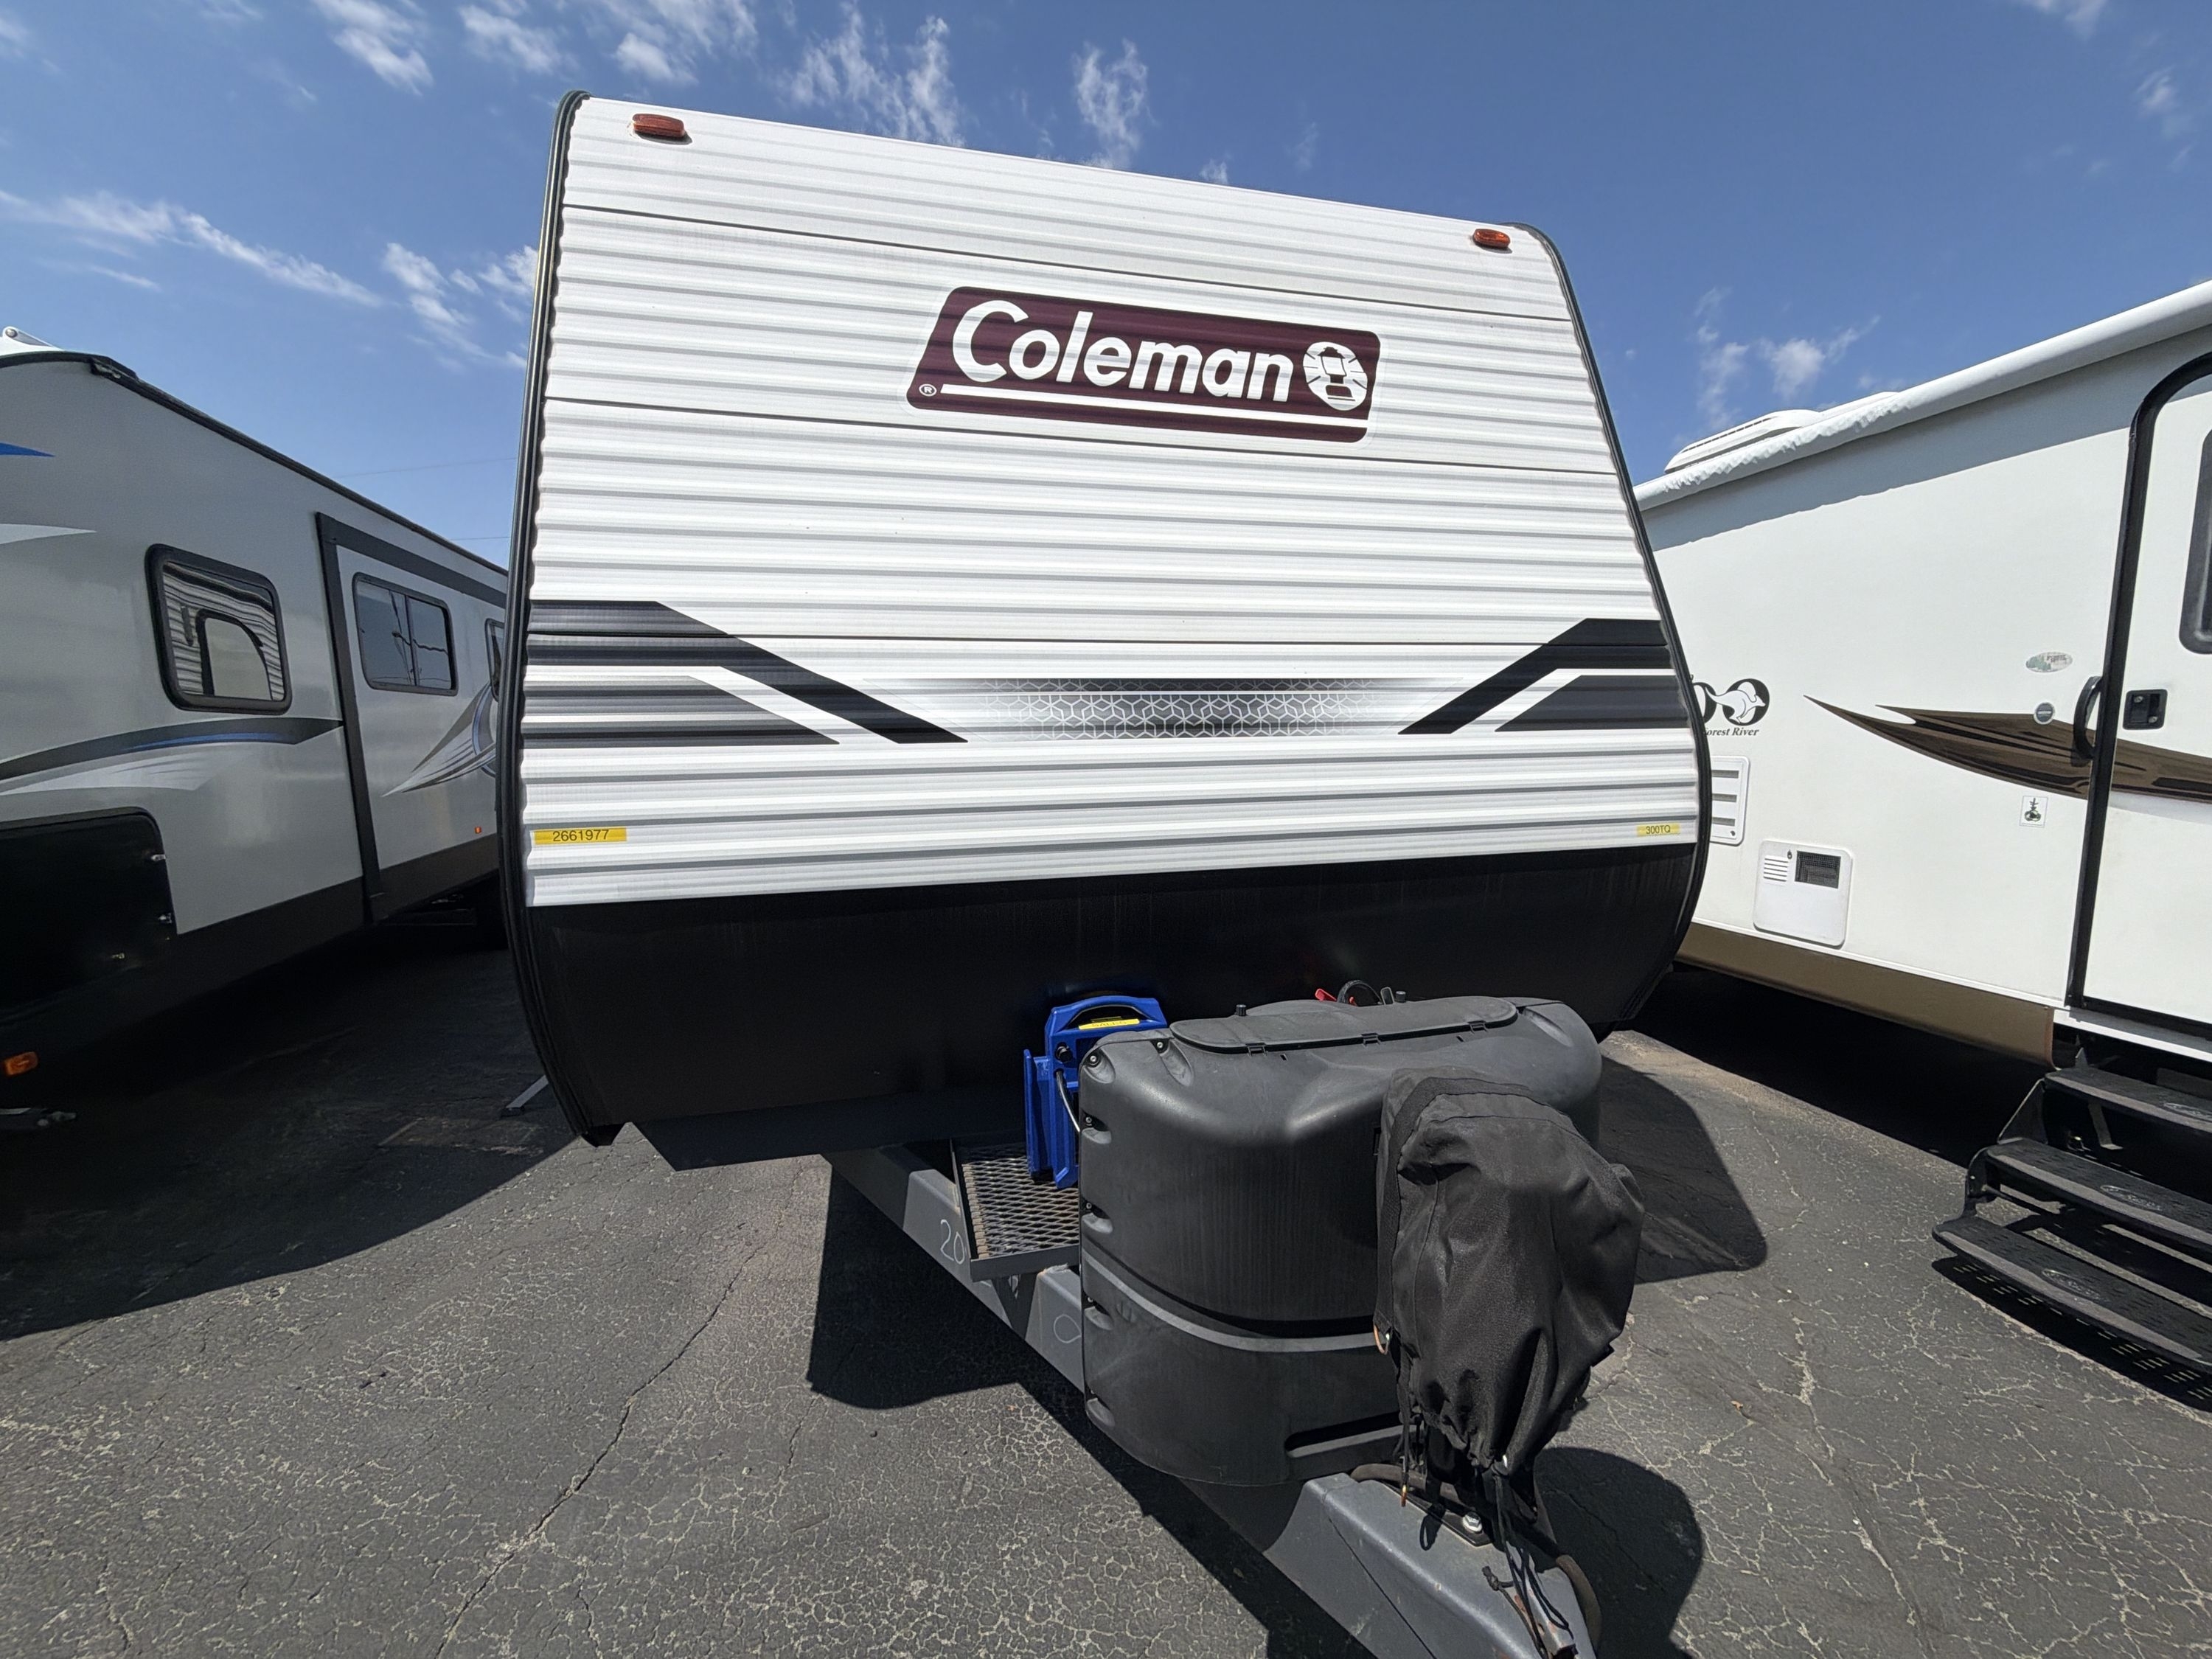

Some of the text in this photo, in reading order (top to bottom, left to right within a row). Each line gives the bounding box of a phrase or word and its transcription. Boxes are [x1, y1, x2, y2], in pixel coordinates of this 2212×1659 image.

[952, 299, 1294, 403] Coleman
[1704, 727, 1759, 736] orest River
[553, 829, 609, 842] 2661977
[1646, 824, 1671, 835] 300TQ
